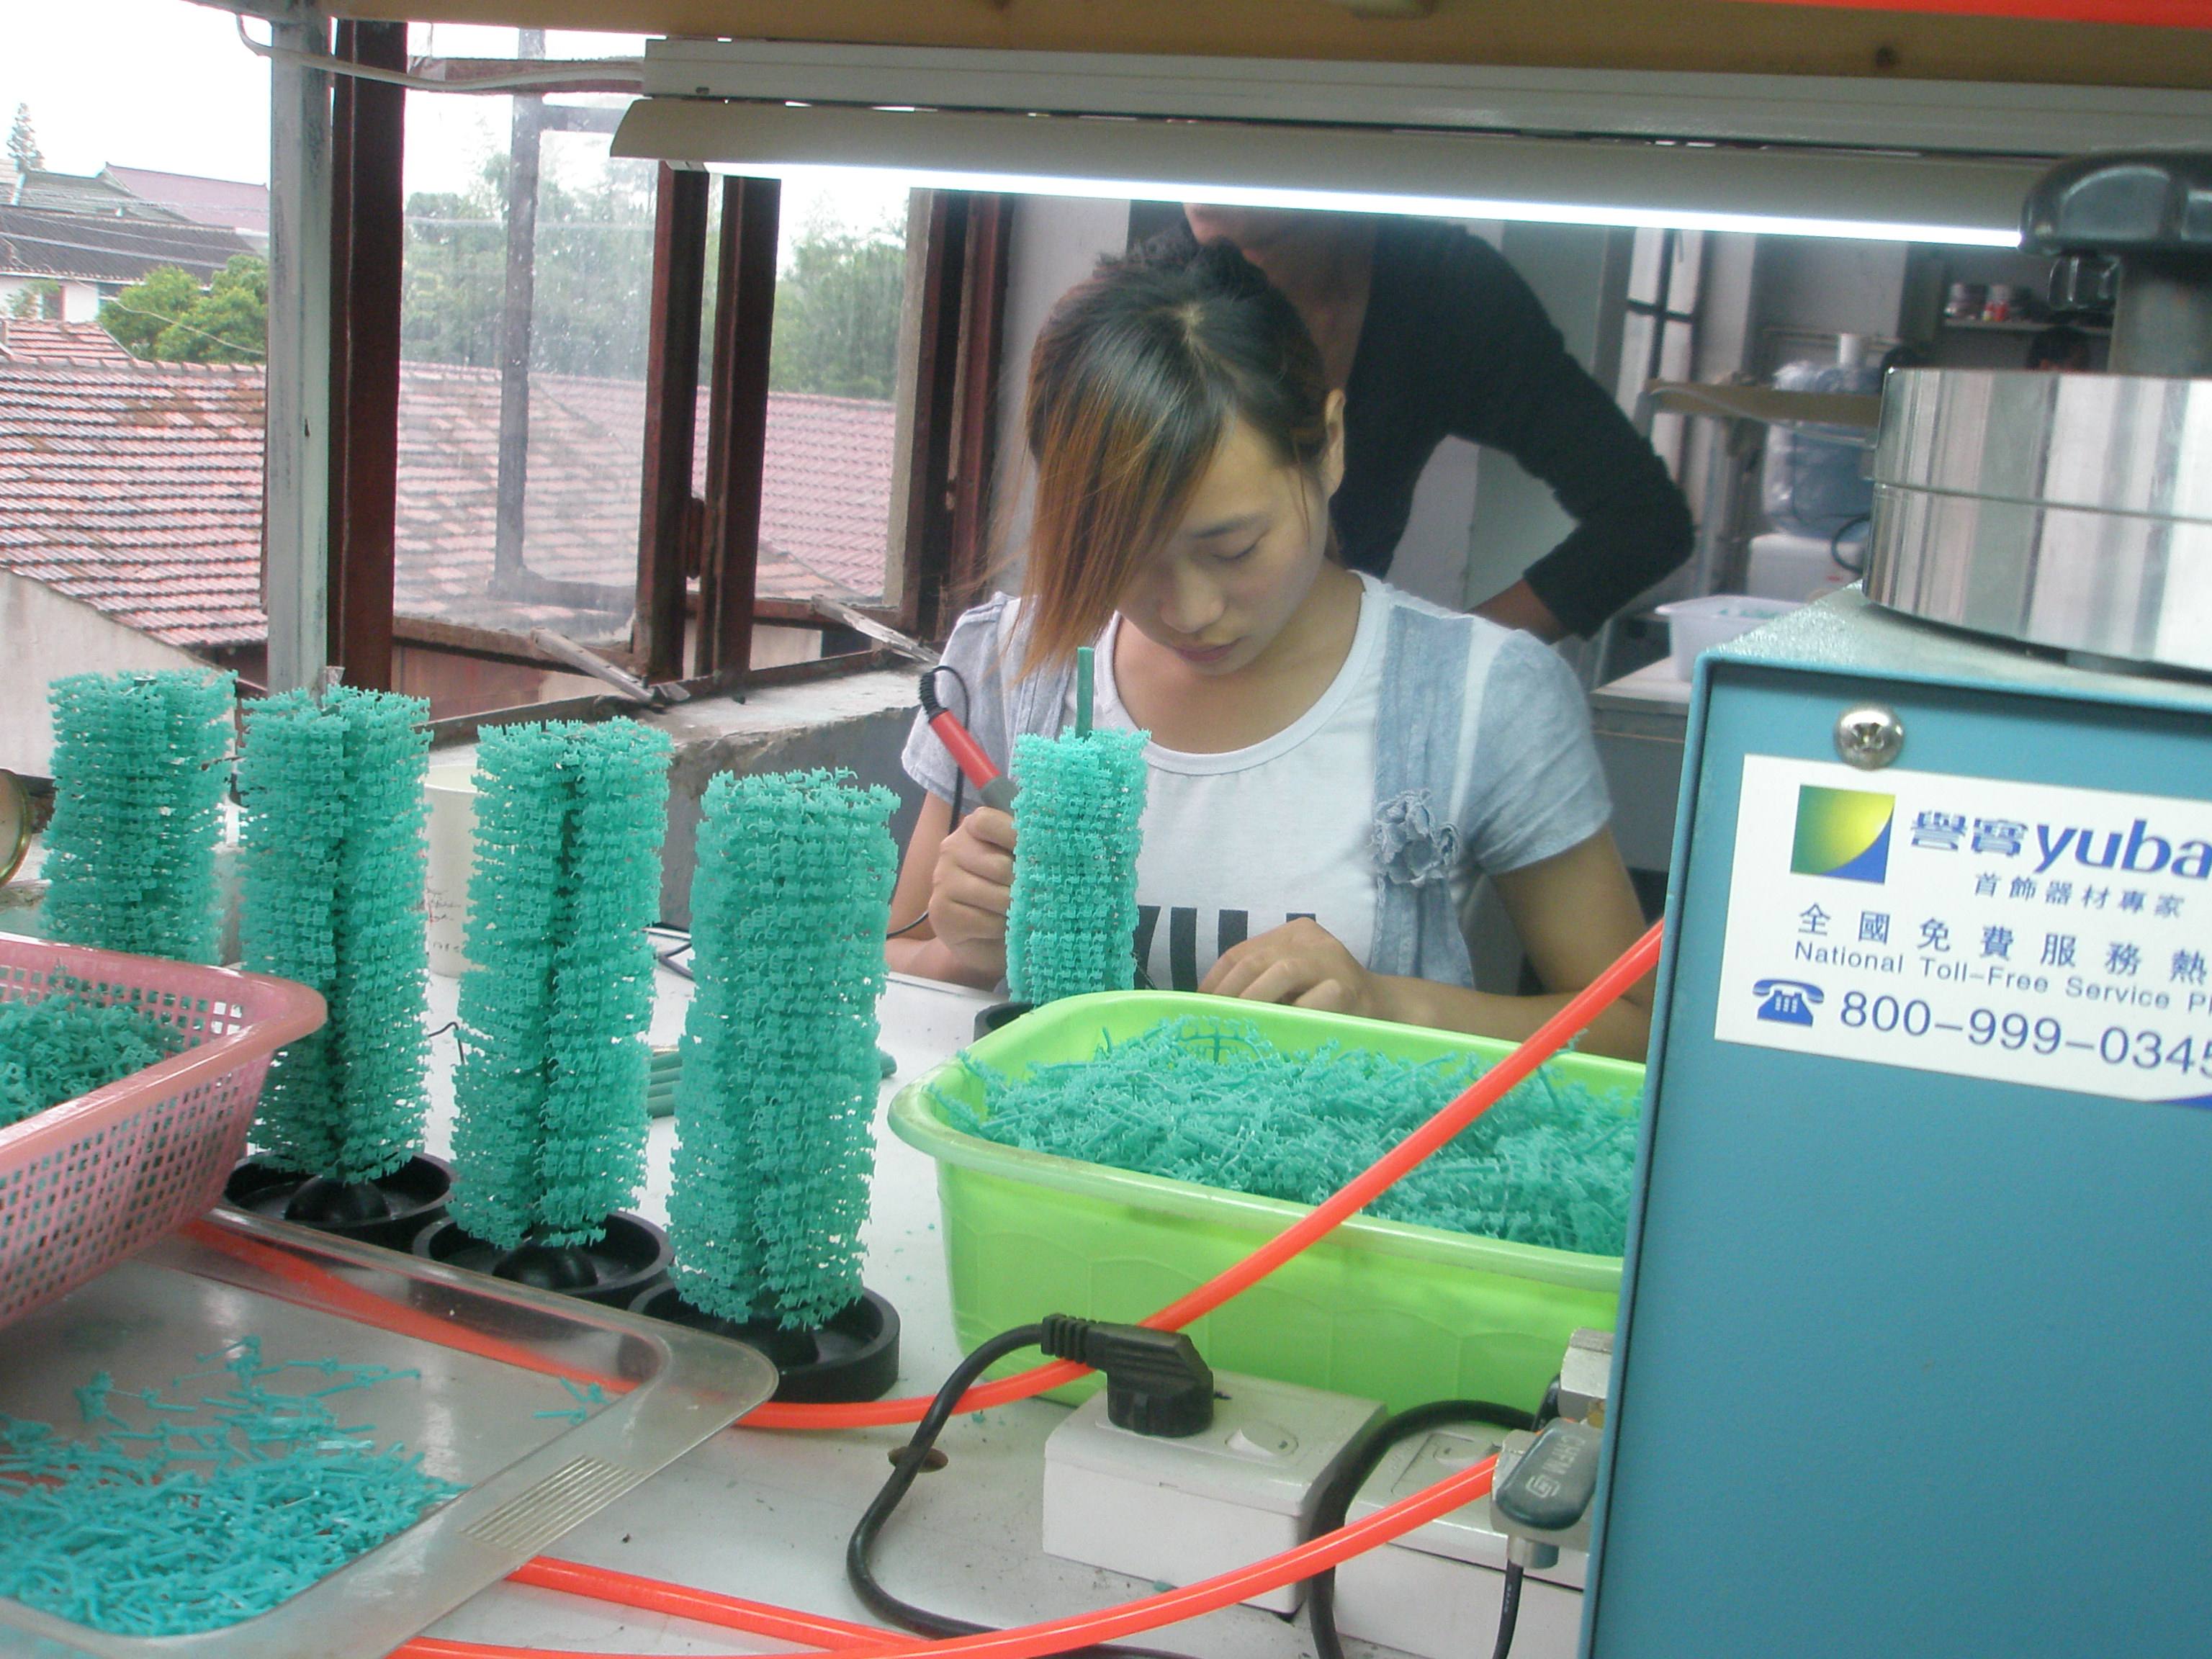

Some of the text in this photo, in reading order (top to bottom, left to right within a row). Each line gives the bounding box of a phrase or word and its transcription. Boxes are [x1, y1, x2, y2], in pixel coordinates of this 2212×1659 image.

[2033, 819, 2211, 879] yuba
[1974, 872, 2185, 919] 首飾器材專家
[1794, 940, 2211, 1015] National Toll-Free Service P
